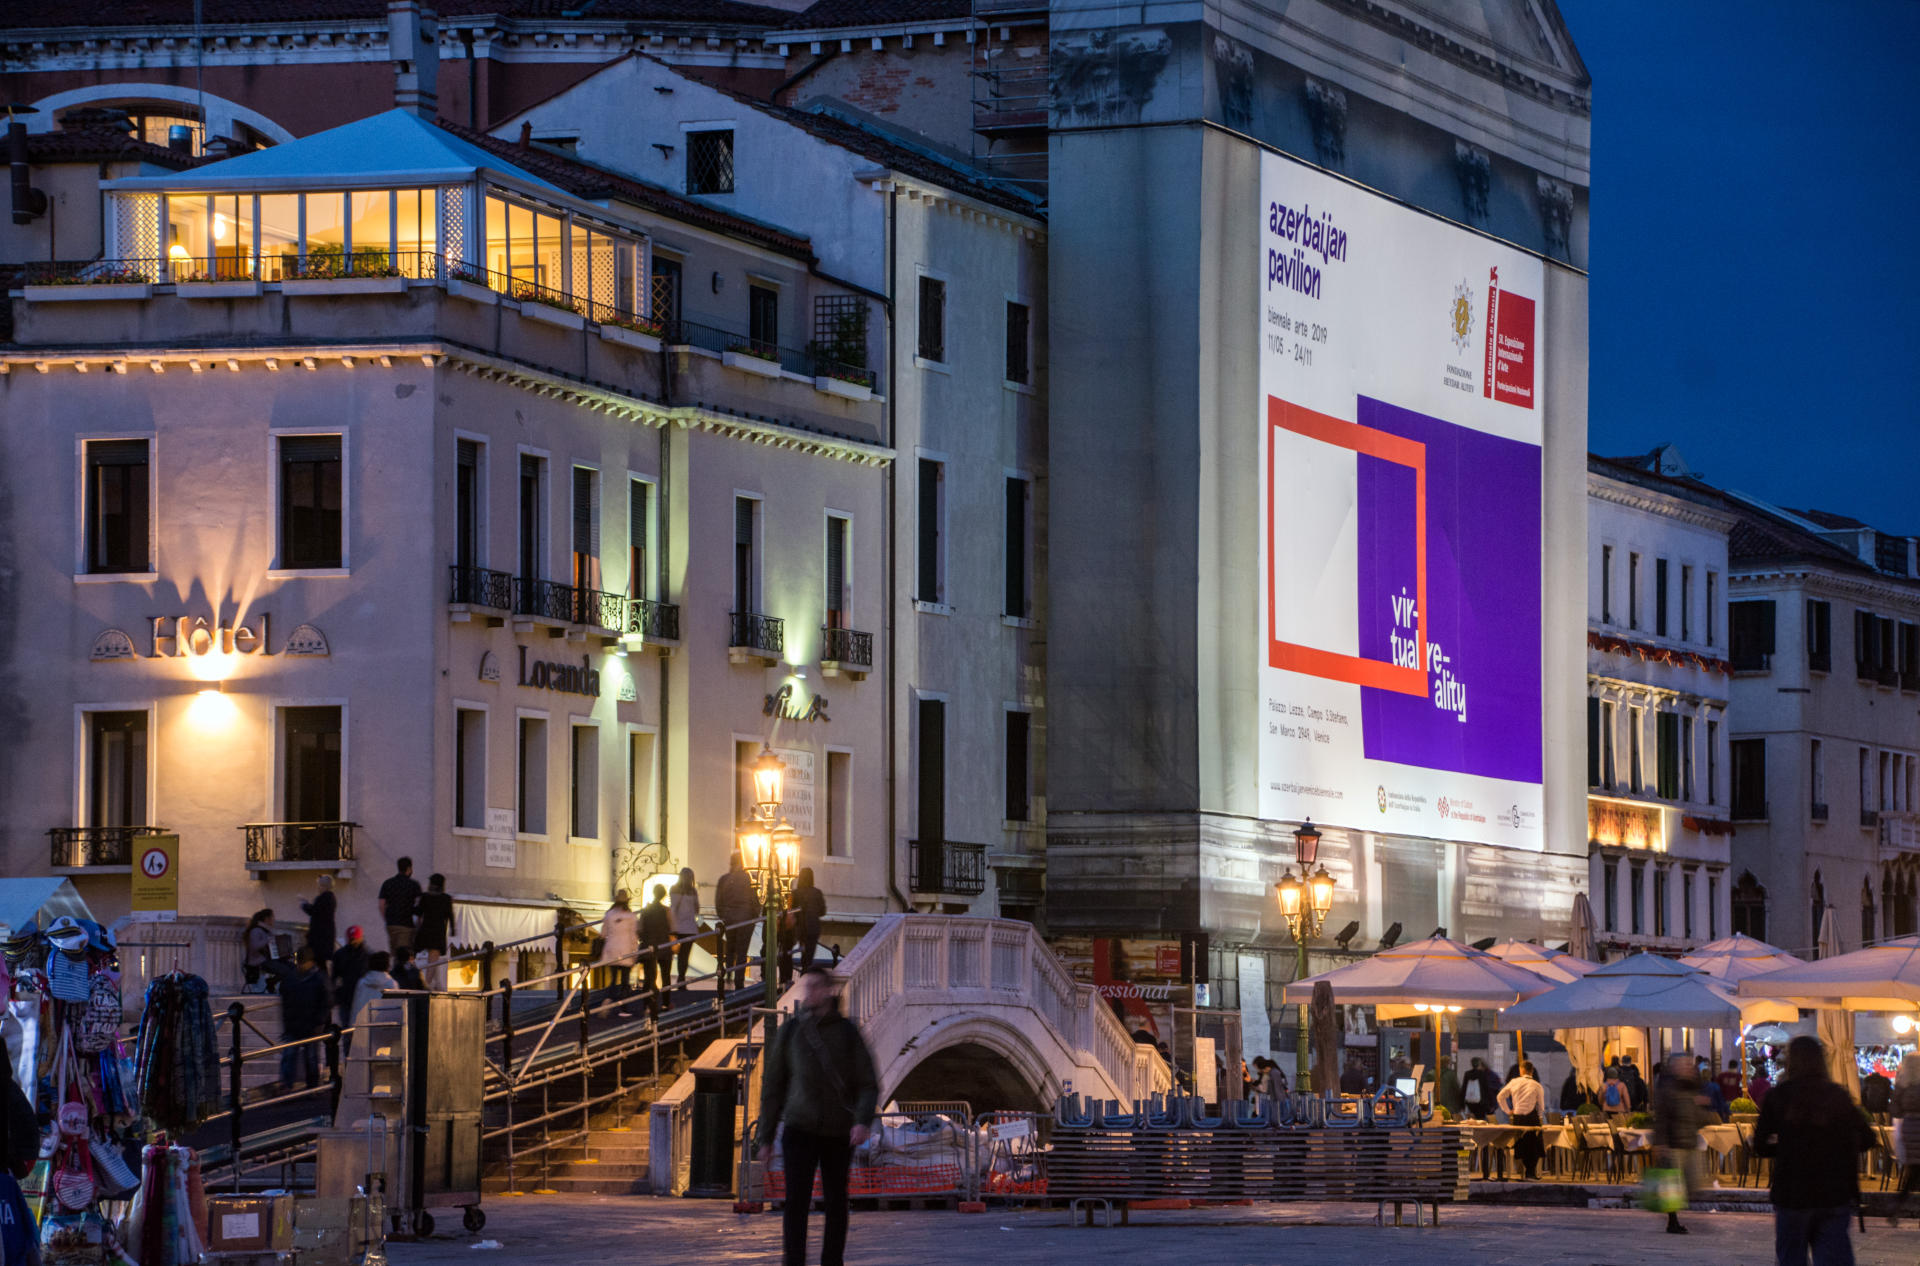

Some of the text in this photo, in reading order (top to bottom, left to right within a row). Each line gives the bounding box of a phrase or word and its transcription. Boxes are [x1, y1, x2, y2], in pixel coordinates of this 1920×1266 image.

[1269, 200, 1347, 265] azerbaijan
[1268, 247, 1322, 300] pavilion
[1268, 305, 1328, 344] biennale arte 2019
[1268, 333, 1284, 355] 11/05
[1294, 344, 1312, 366] 24/11
[1391, 586, 1418, 630] vir-
[146, 612, 272, 658] Hôtel
[1390, 629, 1451, 674] tual re-
[518, 644, 600, 698] Locanda
[1434, 670, 1467, 723] ality
[1269, 722, 1278, 735] San
[1280, 724, 1296, 738] Marco
[1196, 990, 1206, 1001] WC
